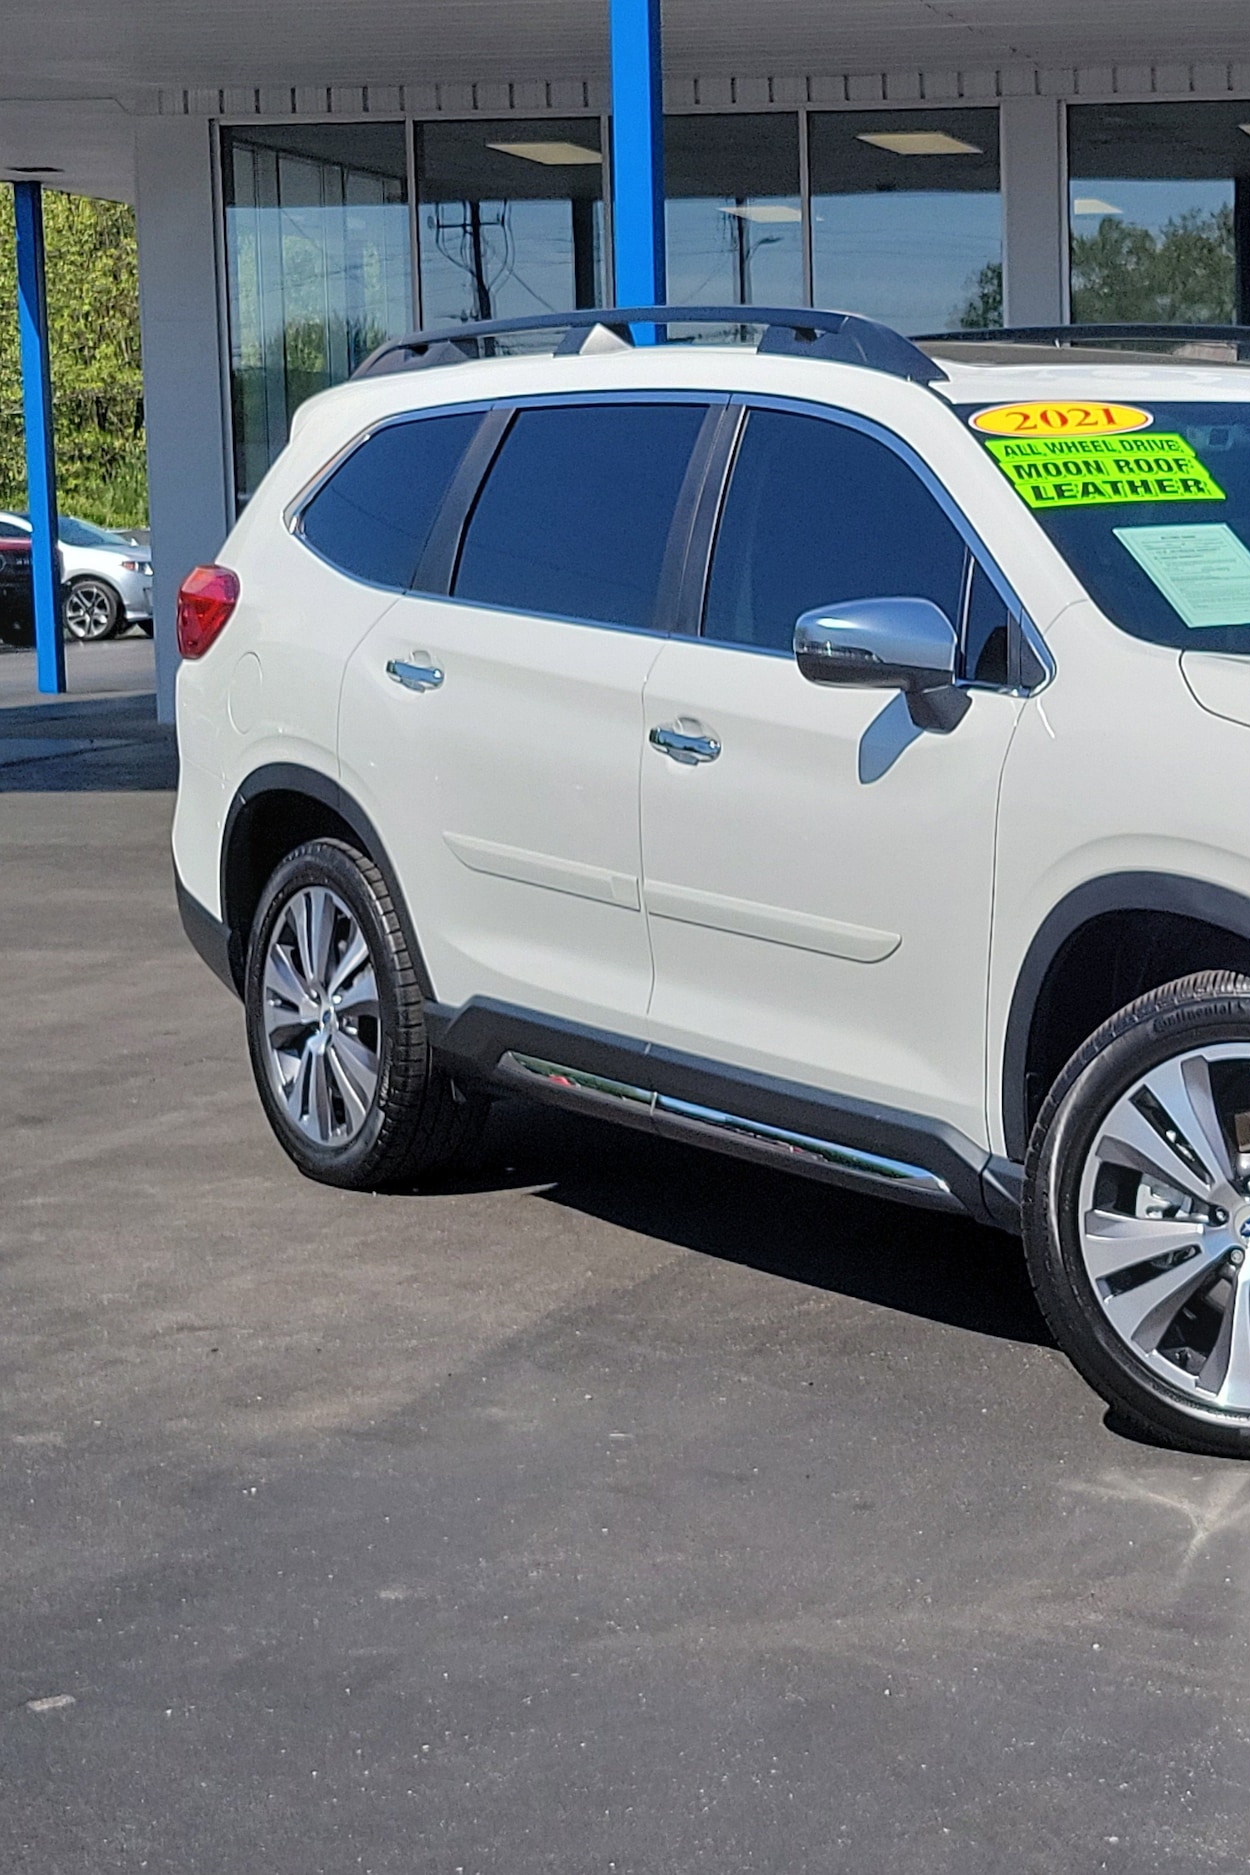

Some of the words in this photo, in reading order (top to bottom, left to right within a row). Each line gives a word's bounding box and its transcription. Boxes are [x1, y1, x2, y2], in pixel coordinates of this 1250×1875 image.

[1006, 407, 1118, 431] 2021
[1004, 441, 1042, 458] ALL
[1044, 439, 1113, 454] WHEEL
[1119, 438, 1180, 452] DRIVE
[1012, 459, 1106, 480] MOON
[1114, 458, 1190, 475] ROOF
[1030, 478, 1208, 501] LEATHER
